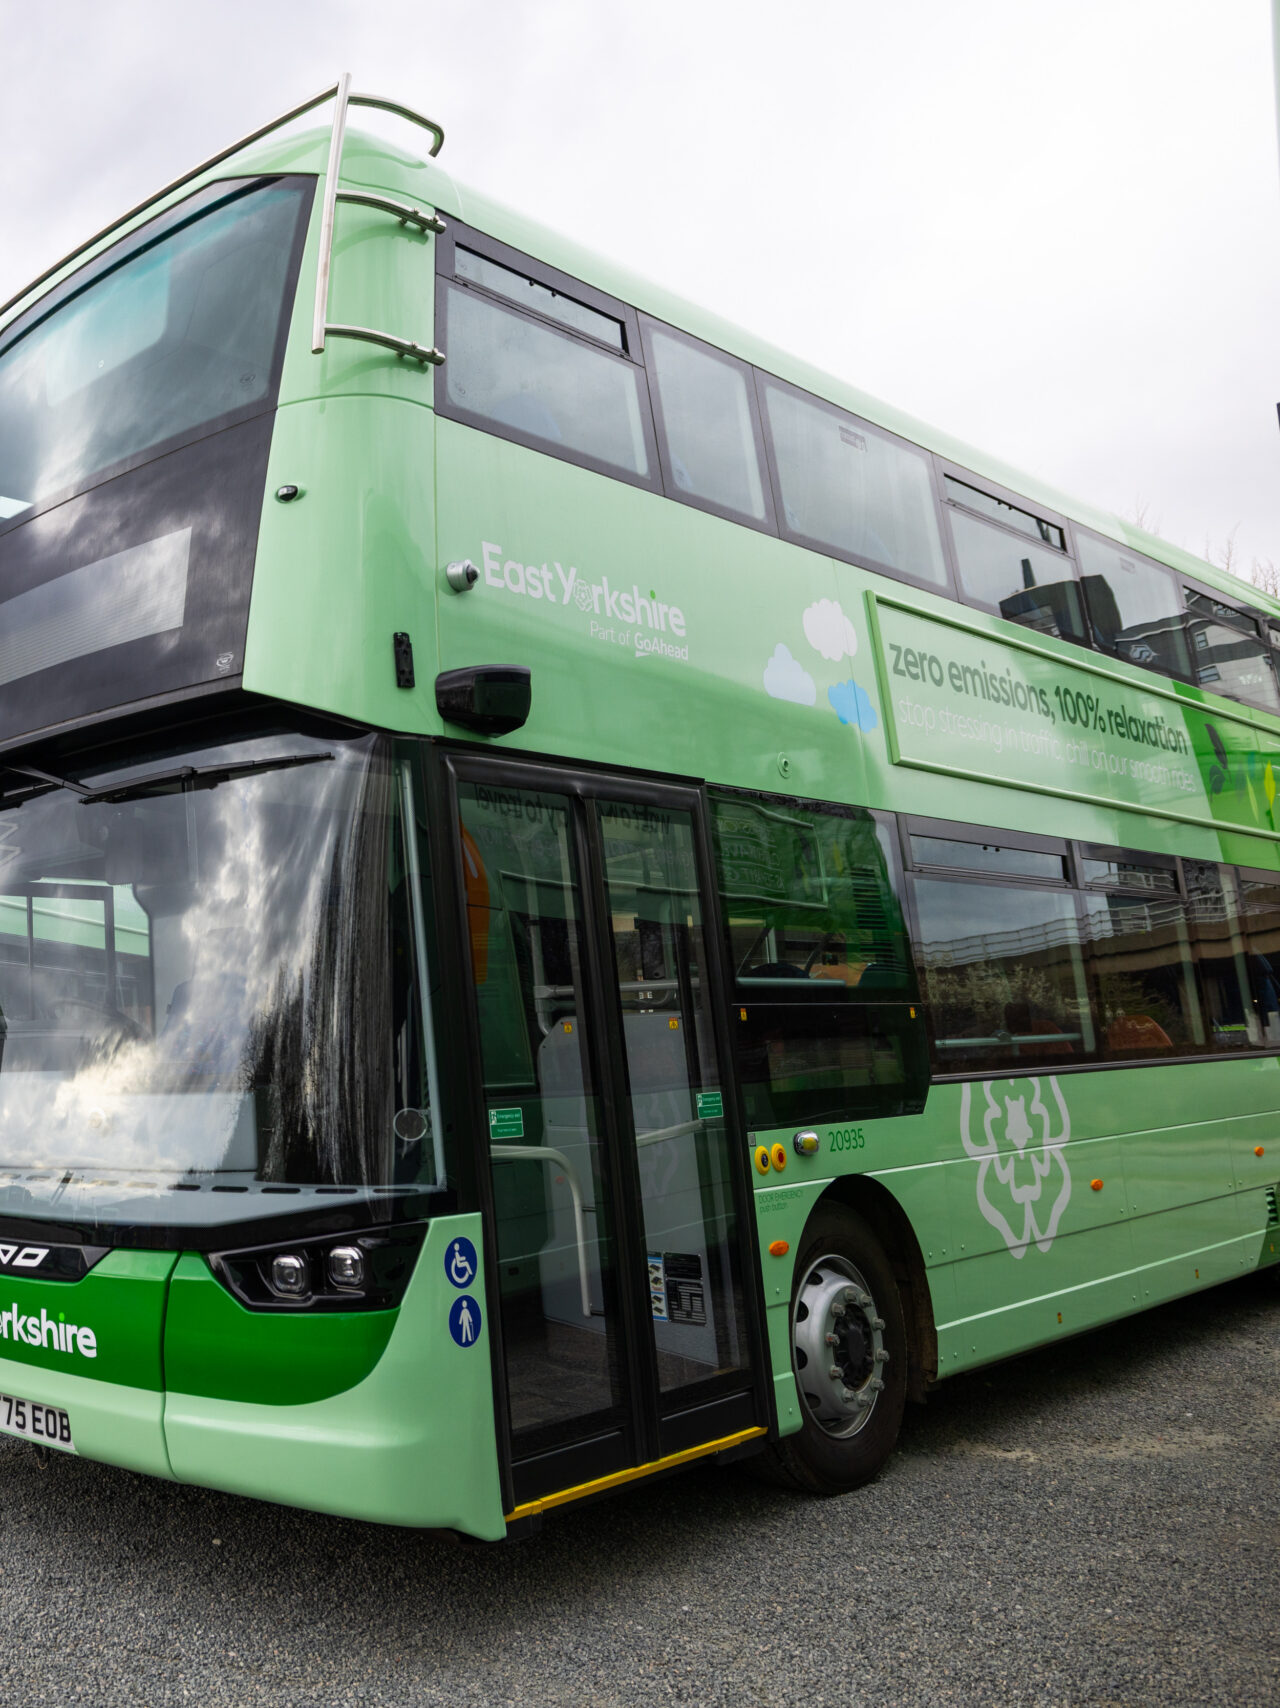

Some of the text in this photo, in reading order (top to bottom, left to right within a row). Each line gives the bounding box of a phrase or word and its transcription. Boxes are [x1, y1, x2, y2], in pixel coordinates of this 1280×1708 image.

[481, 540, 687, 637] East Yorkshire
[590, 620, 689, 661] Part of GoAhead
[889, 643, 1189, 756] zero emissions, 100% relaxation
[898, 696, 936, 736] stop
[938, 704, 1002, 753] stressing
[1005, 720, 1017, 747] in
[1066, 738, 1090, 768] chill
[1091, 749, 1108, 771] on
[1109, 753, 1128, 776] our
[828, 1128, 866, 1153] 20935
[31, 1403, 72, 1444] EOB
